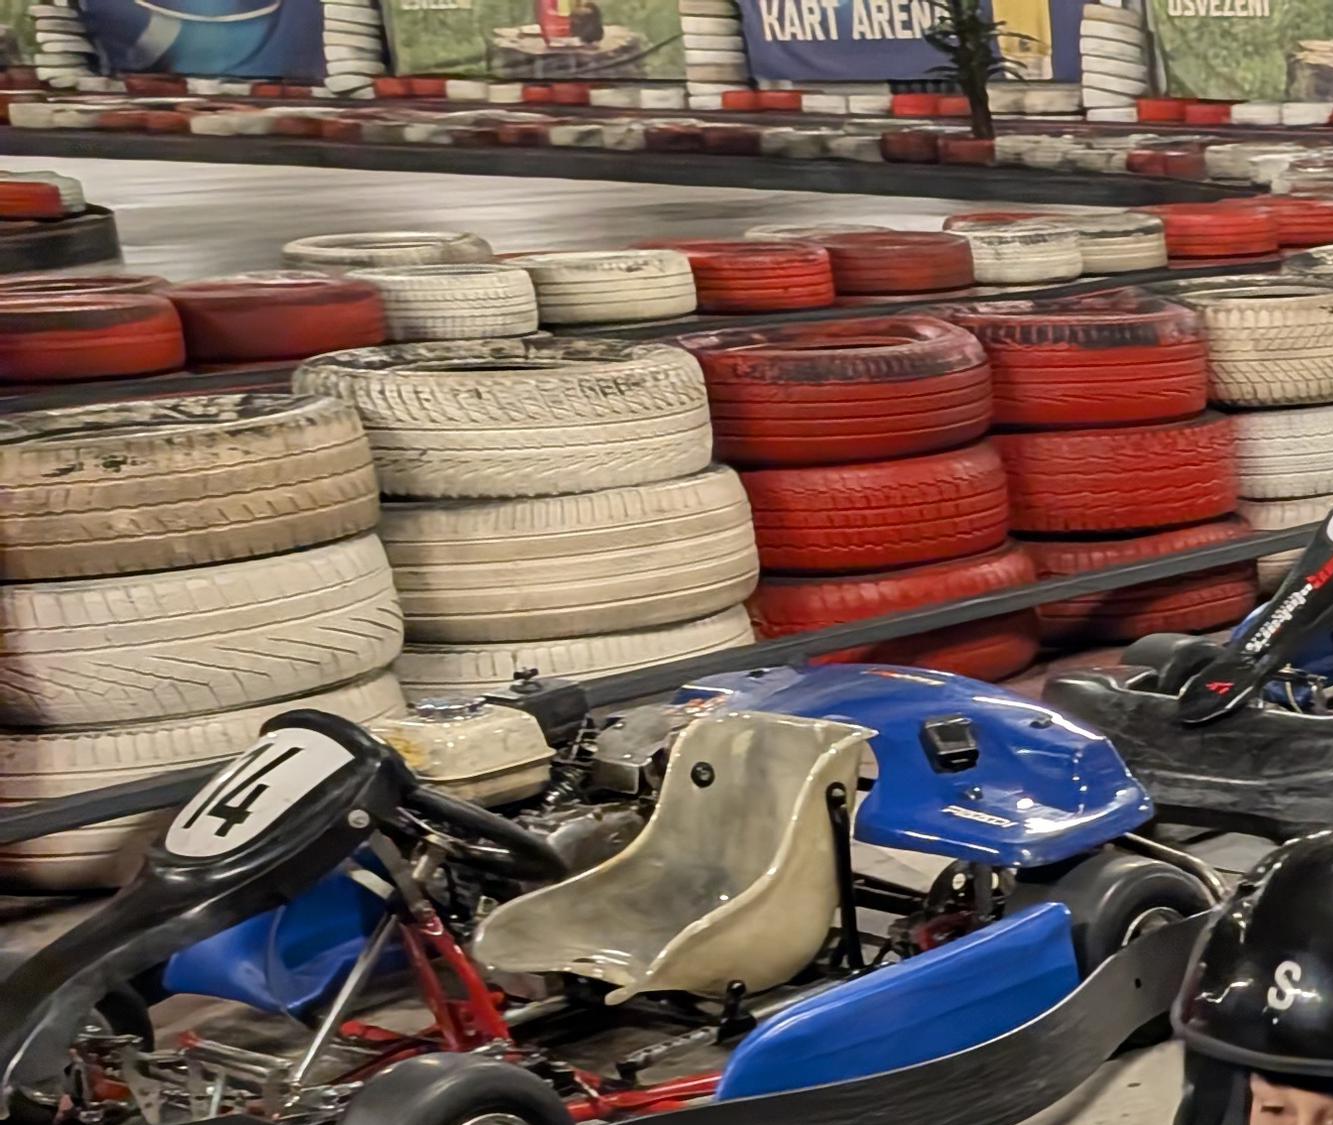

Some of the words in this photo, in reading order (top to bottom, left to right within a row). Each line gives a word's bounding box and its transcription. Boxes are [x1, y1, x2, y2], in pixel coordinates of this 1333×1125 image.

[760, 0, 839, 41] KART
[183, 742, 303, 837] 14
[1267, 961, 1302, 1010] S
